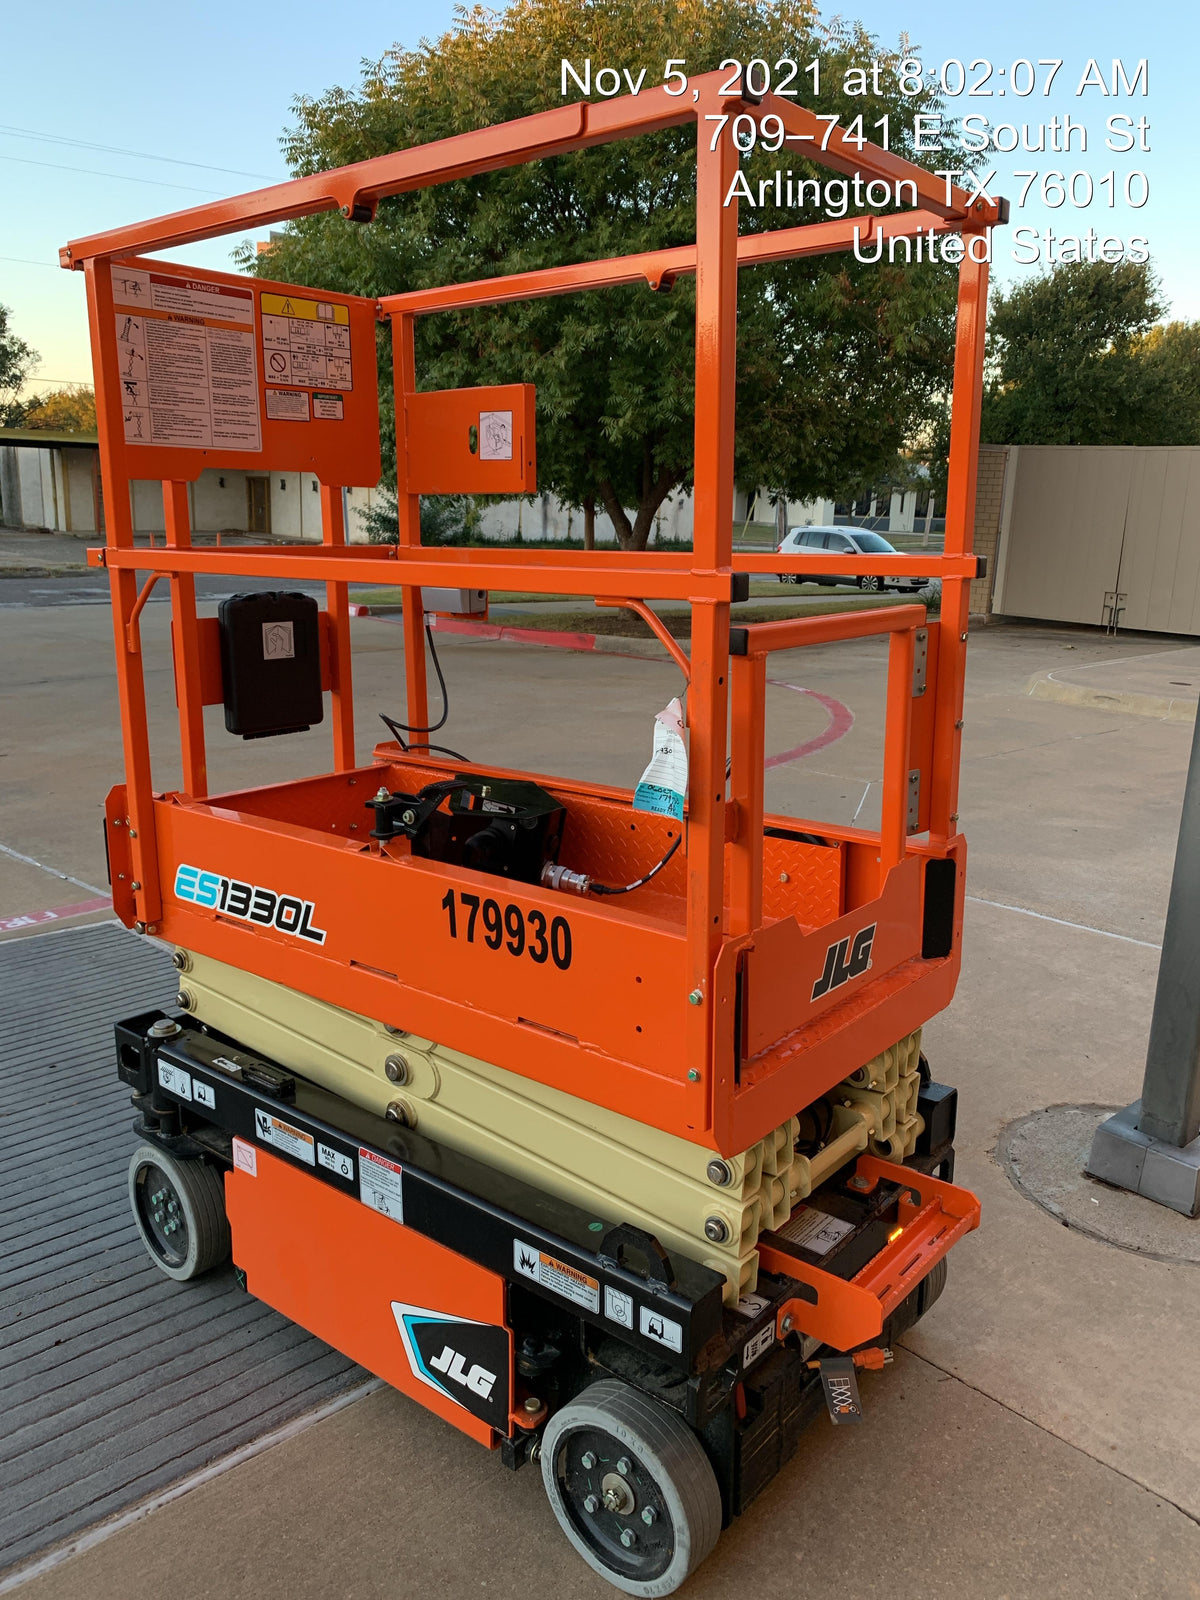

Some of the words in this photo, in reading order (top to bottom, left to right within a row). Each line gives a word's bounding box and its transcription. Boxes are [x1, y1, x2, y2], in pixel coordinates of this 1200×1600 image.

[192, 282, 220, 294] DANGER
[174, 314, 205, 326] WARNING
[174, 864, 327, 945] ES1330L
[442, 888, 572, 970] 179930
[810, 921, 877, 1003] JLG
[321, 1147, 336, 1160] MAX
[371, 1154, 395, 1171] DANGER
[555, 1262, 588, 1284] WARNING
[429, 1345, 498, 1401] JLG
